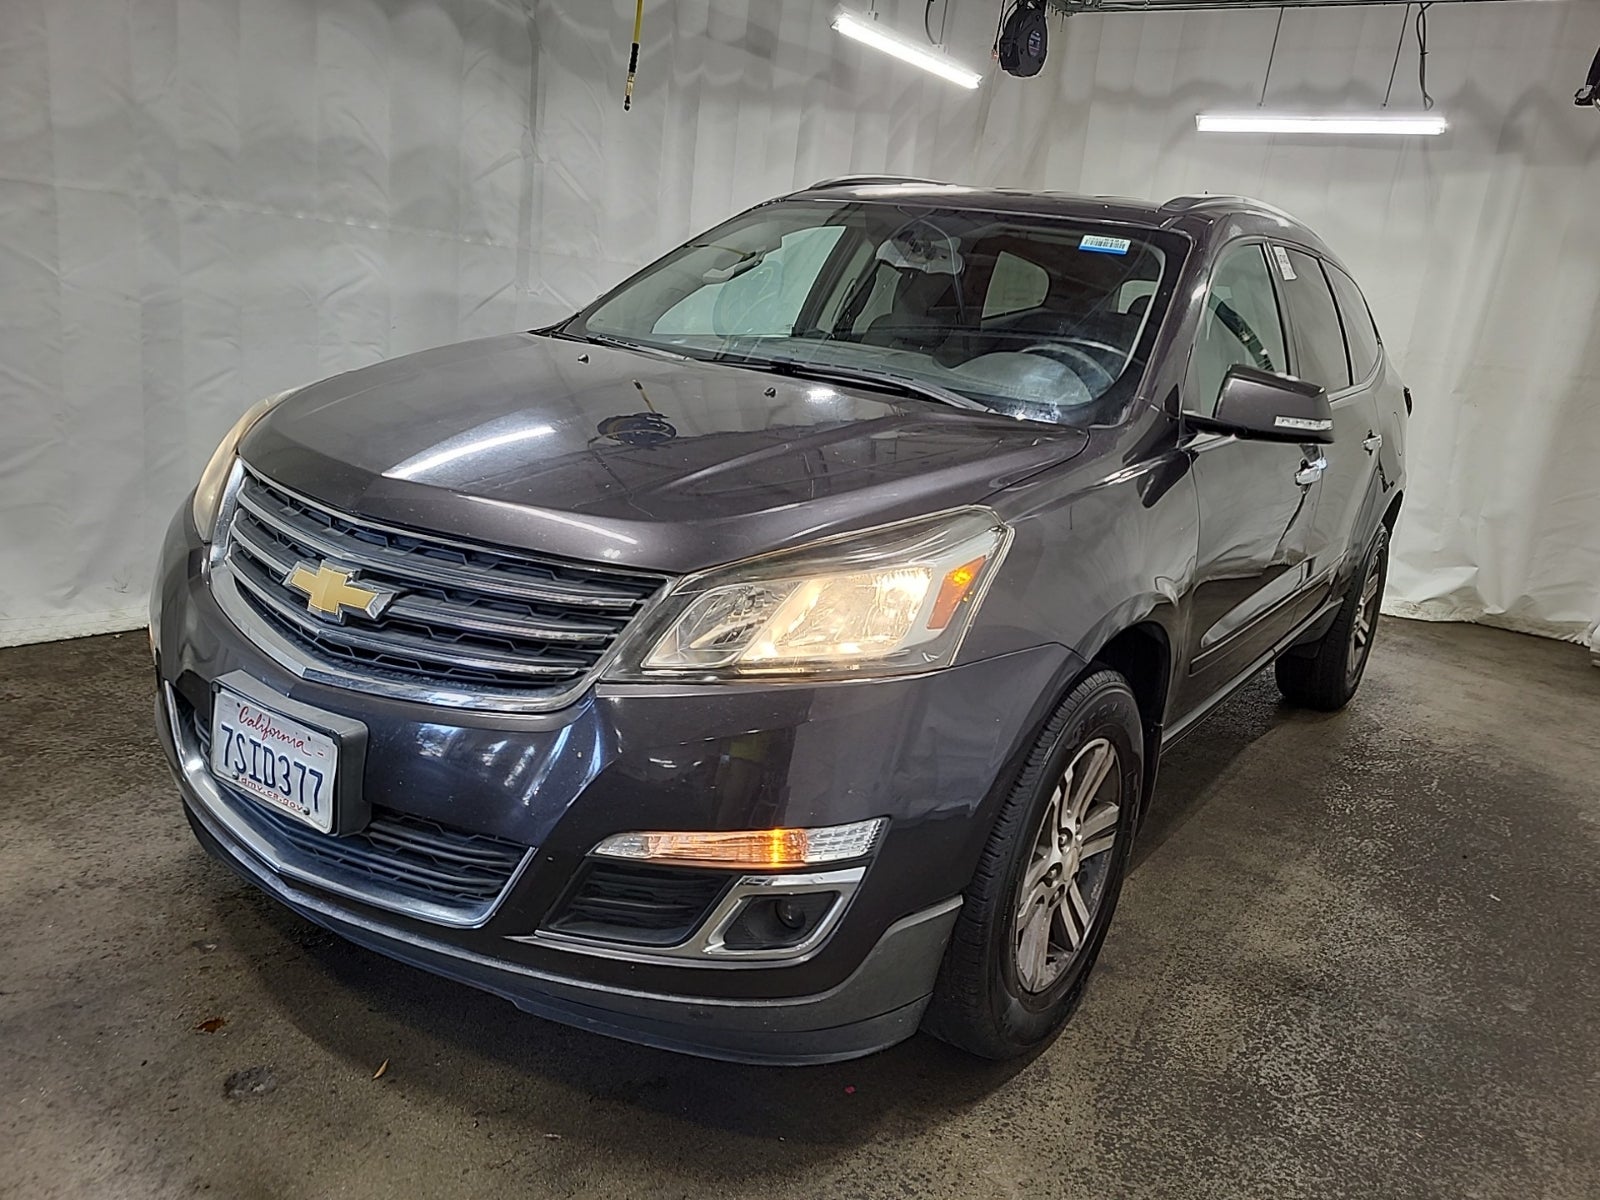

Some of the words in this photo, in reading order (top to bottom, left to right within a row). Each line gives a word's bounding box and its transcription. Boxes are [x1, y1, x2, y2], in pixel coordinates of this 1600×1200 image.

[239, 706, 311, 756] California
[221, 723, 323, 812] 7SID377
[241, 776, 303, 811] dmv.ca.gov
